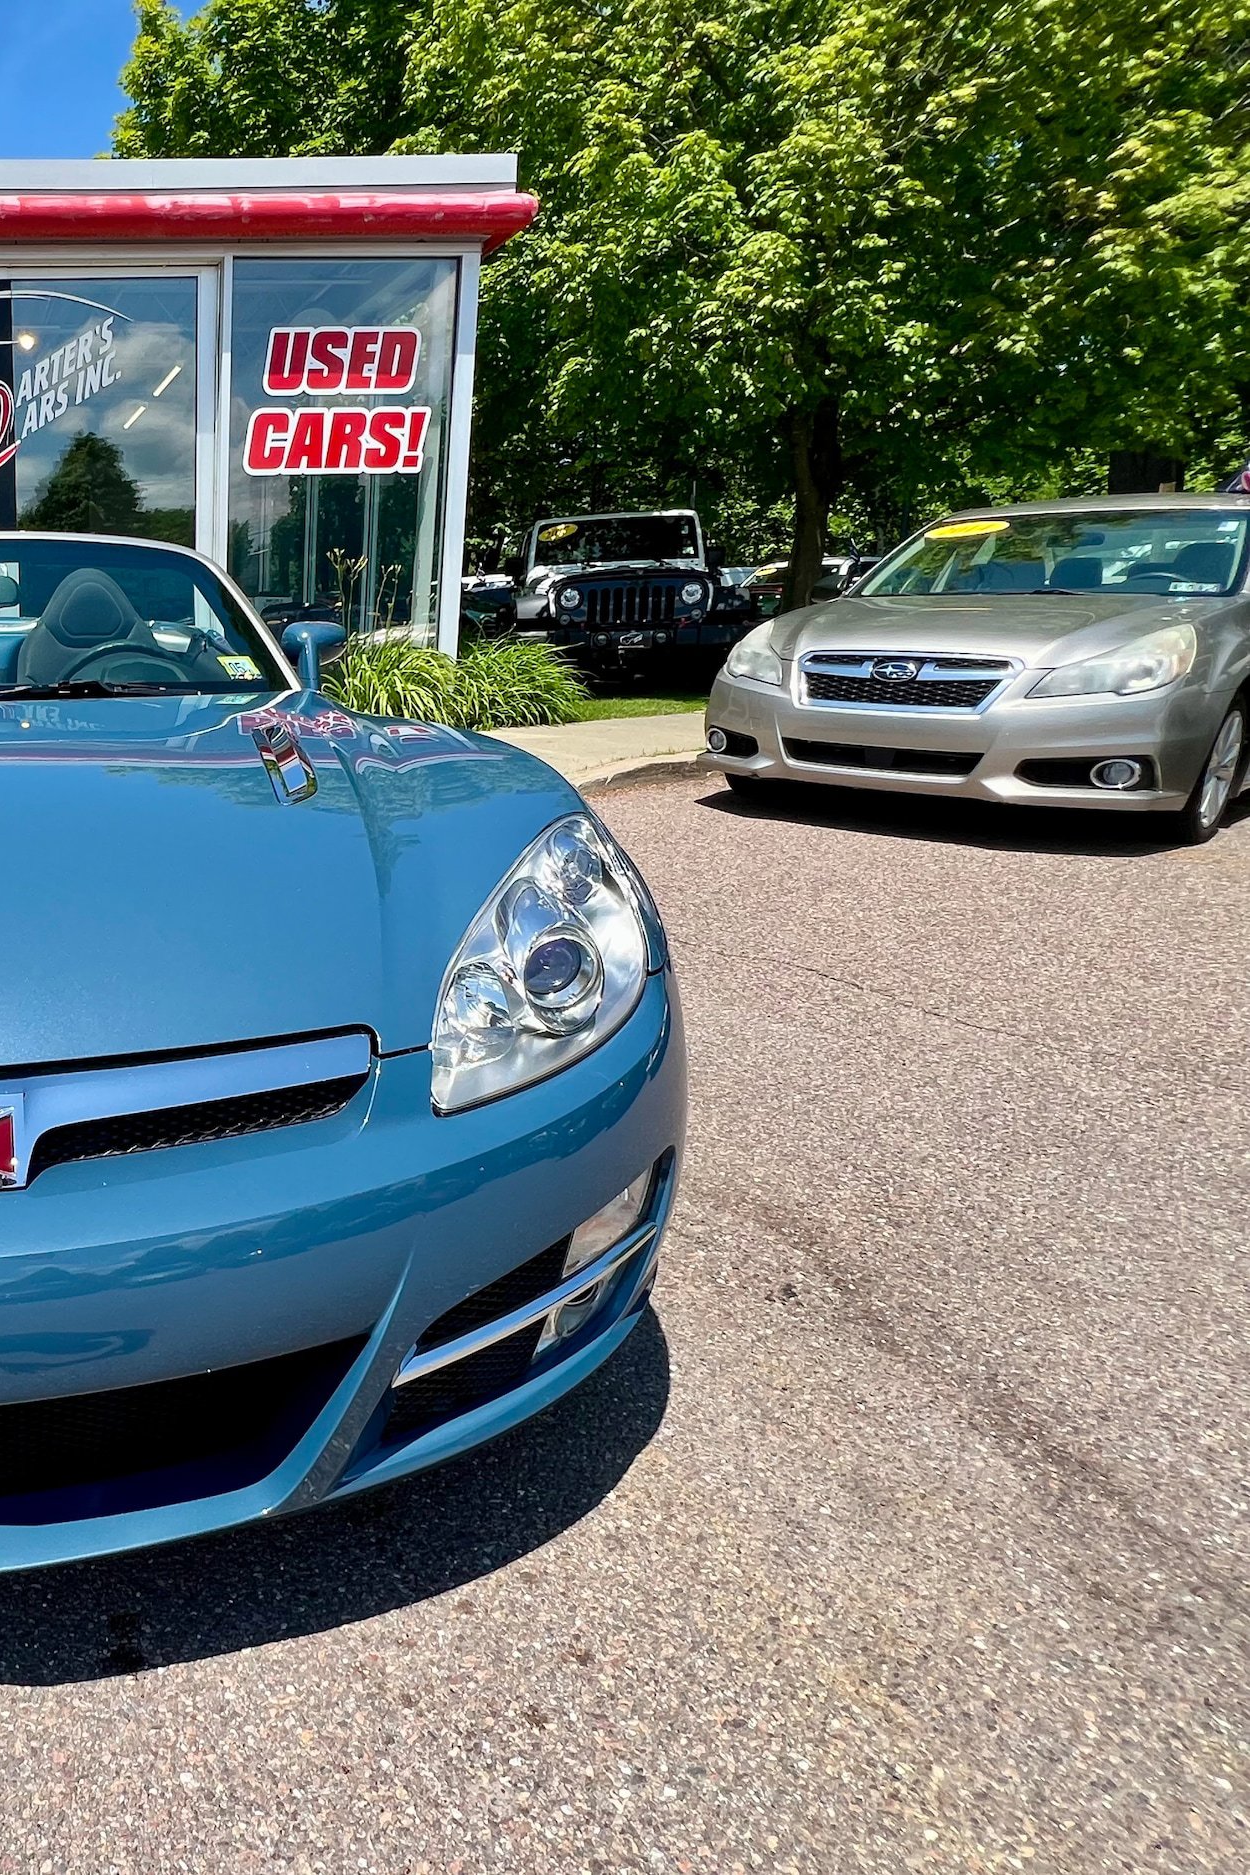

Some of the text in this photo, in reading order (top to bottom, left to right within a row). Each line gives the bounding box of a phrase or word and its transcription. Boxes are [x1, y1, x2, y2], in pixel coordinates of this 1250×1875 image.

[75, 351, 122, 405] INC.
[265, 329, 419, 392] USED
[245, 409, 429, 472] CARS!
